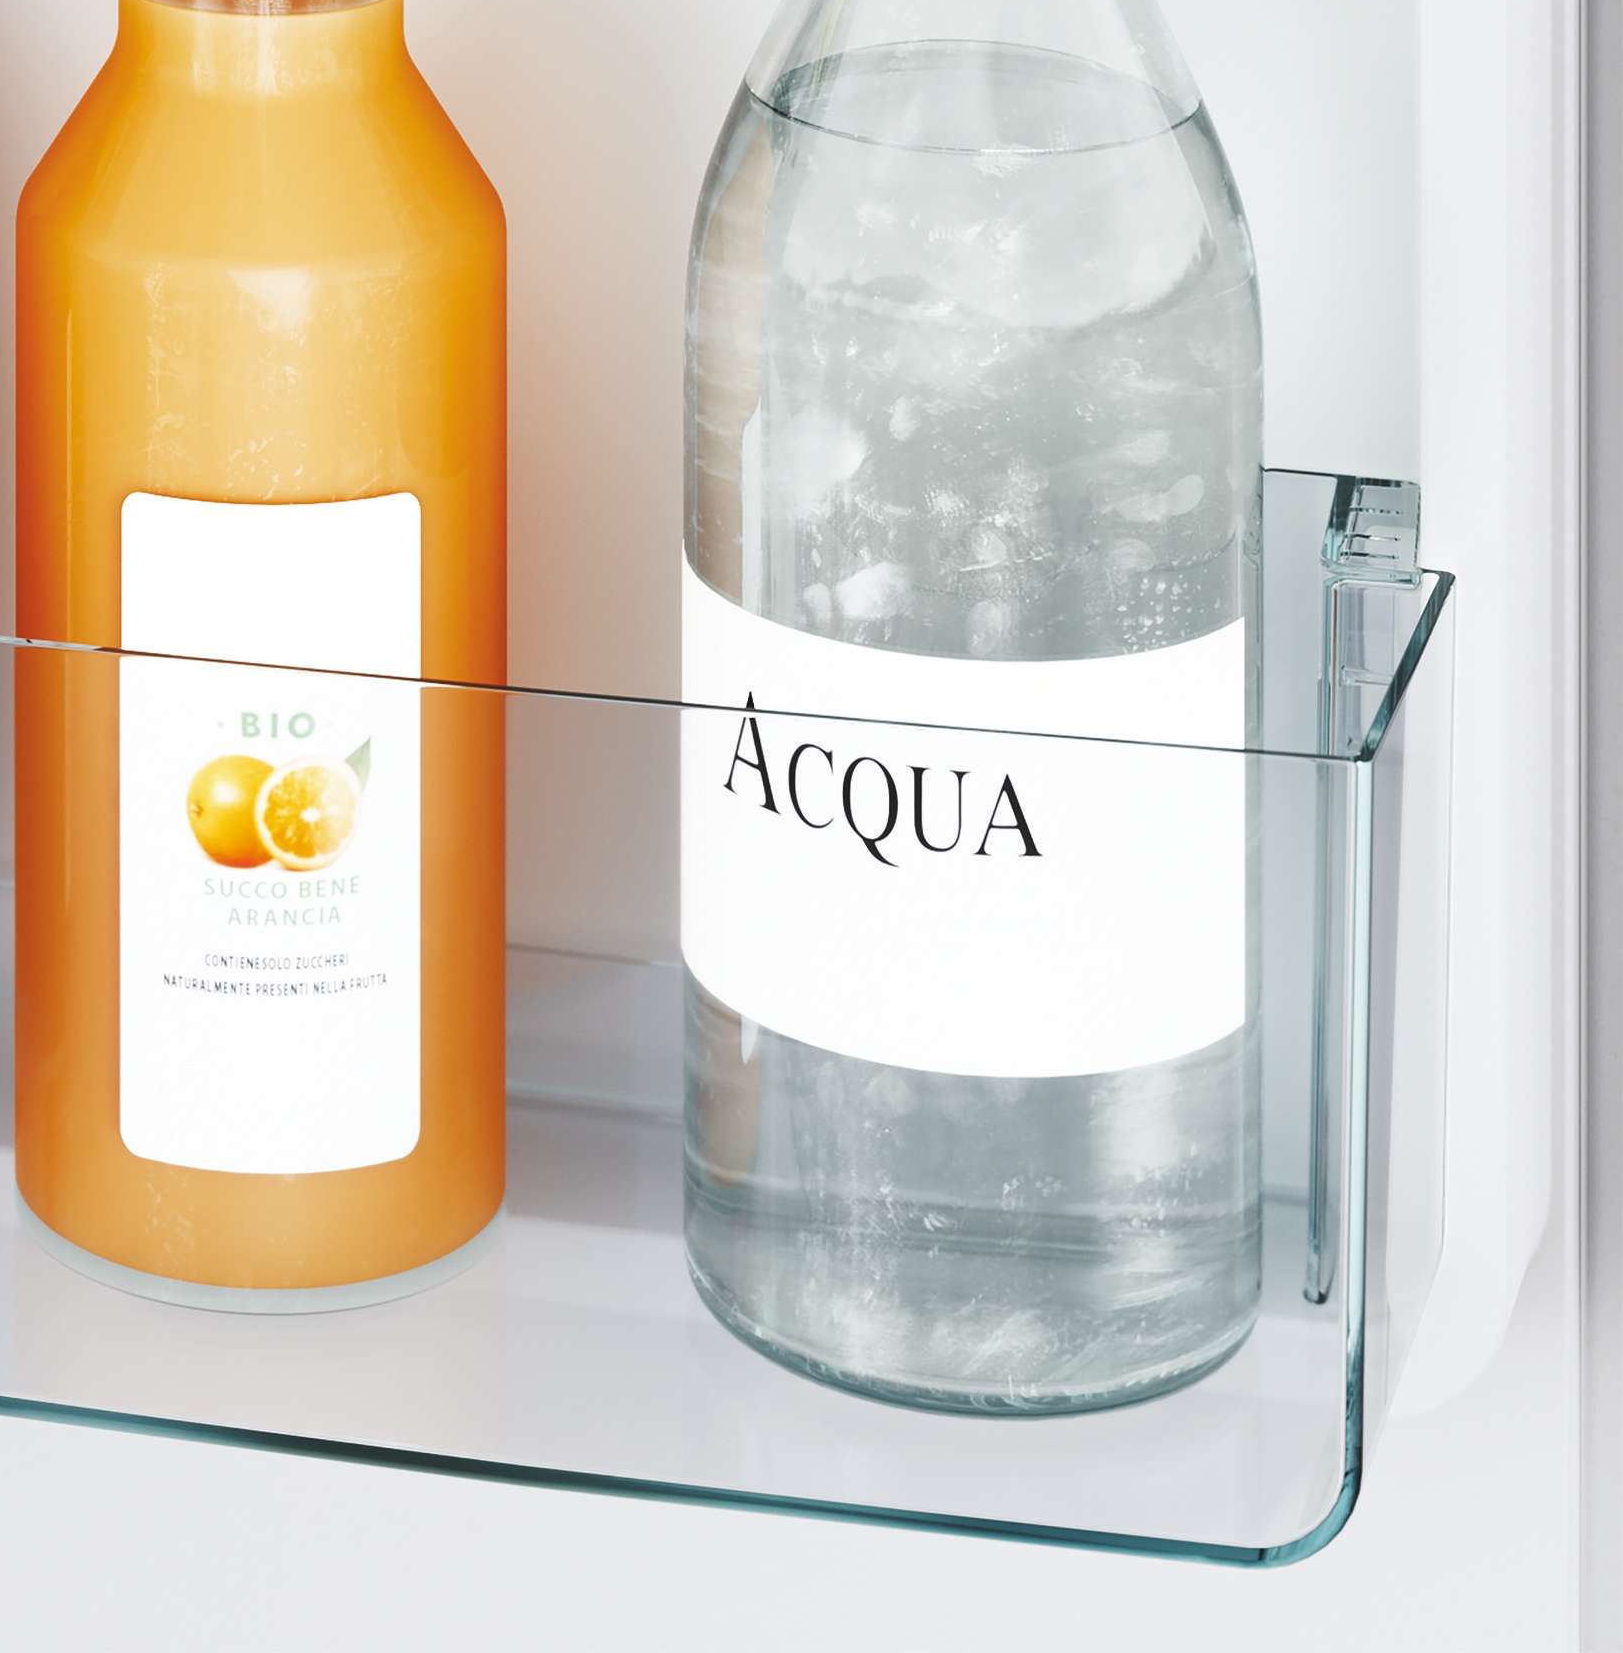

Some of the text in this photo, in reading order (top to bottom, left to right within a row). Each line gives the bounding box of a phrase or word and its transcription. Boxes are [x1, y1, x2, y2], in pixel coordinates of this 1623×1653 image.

[240, 711, 316, 740] BIO
[722, 690, 1045, 868] ACQUA
[204, 875, 362, 900] SUCCO BENE
[227, 905, 342, 927] ARANCIA
[295, 952, 350, 971] ZUCCHERI
[162, 972, 388, 997] NATURALMENTE PRESENTI NELLA FRUTTA
